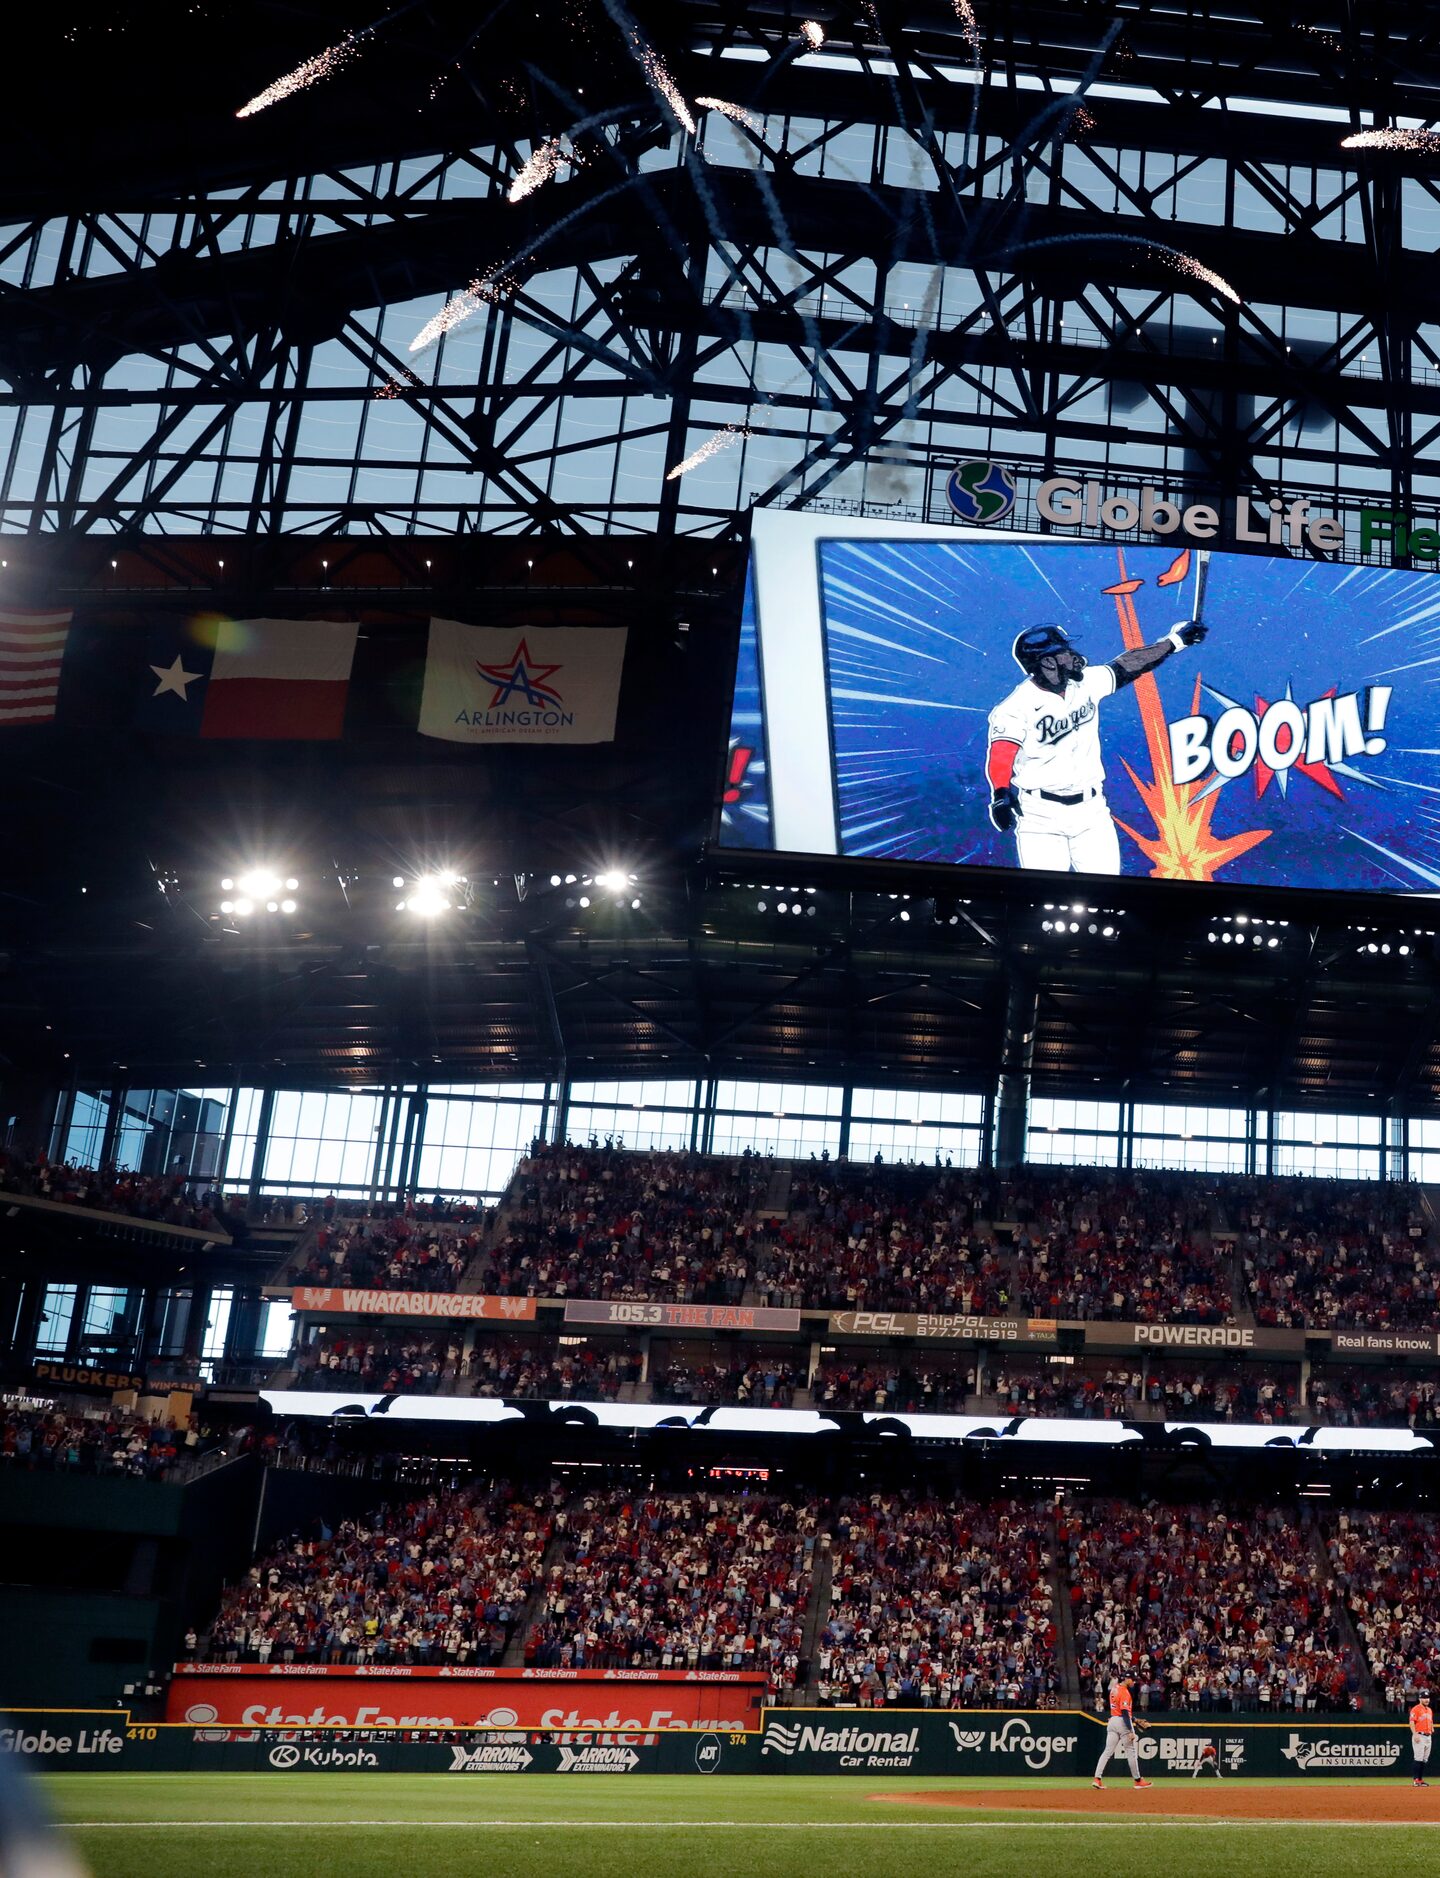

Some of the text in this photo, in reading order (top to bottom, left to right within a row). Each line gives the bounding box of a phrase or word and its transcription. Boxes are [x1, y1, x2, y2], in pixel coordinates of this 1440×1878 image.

[1036, 477, 1220, 539] Globe
[1235, 495, 1345, 552] Life
[454, 709, 574, 726] ARLINGTON
[1168, 686, 1393, 786] BOOM!
[342, 1290, 486, 1317] WHATABURGER
[608, 1304, 754, 1327] 105.3 THE FAN
[853, 1312, 905, 1331] PGL
[917, 1314, 1018, 1329] ShipPGL.com
[916, 1327, 1018, 1340] 877.701.1919
[1133, 1324, 1255, 1347] POWERADE
[1337, 1335, 1432, 1350] Real fans know.
[36, 1364, 144, 1389] PLUCKERS
[0, 1728, 124, 1754] Globe Life
[126, 1727, 158, 1741] 410
[729, 1733, 747, 1746] 374
[990, 1718, 1078, 1770] Kroger
[1114, 1737, 1212, 1760] BG BITE
[1315, 1740, 1400, 1757] Germania
[303, 1748, 377, 1766] Kubota
[472, 1746, 520, 1763] ARROW
[578, 1748, 627, 1763] ARROW
[699, 1747, 717, 1760] ADT
[840, 1755, 913, 1767] Car Rental
[1321, 1758, 1385, 1766] INSURANCE
[465, 1762, 520, 1771] EXTERMINATORS
[572, 1763, 627, 1772] EXTERMINATORS
